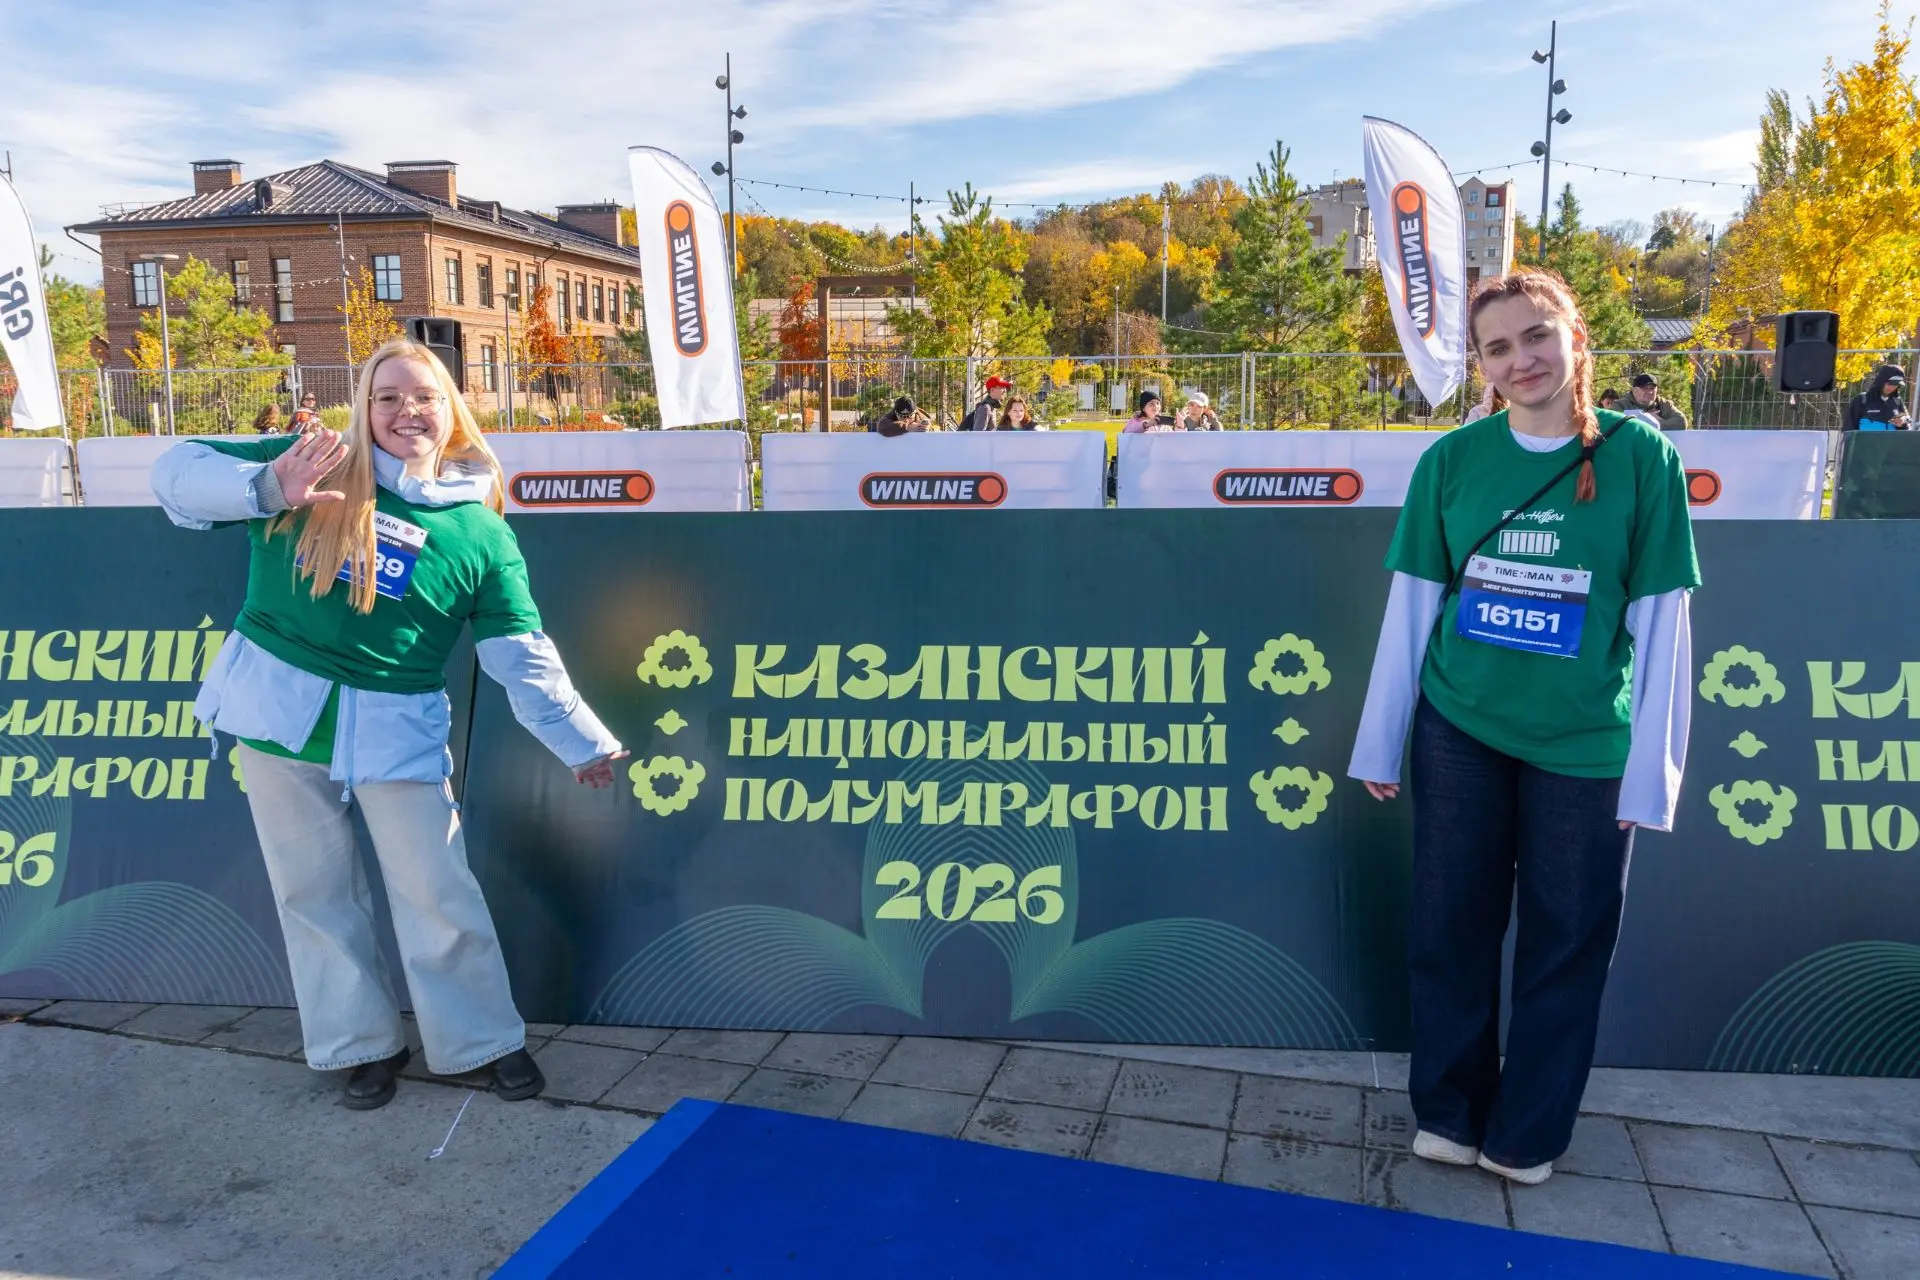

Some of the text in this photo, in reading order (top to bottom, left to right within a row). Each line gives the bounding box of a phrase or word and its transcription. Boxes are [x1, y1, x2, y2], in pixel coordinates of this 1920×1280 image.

[520, 478, 623, 500] WINLINE
[871, 480, 975, 501] WINLINE
[1225, 476, 1331, 497] WINLINE
[1477, 602, 1561, 634] 16151
[731, 630, 1227, 704] КАЗАНСКИЙ
[728, 713, 1228, 769] НАЦИОНАЛЬНЫЙ
[723, 777, 1229, 831] ПОЛУМАРАФОН
[875, 860, 1065, 925] 2026
